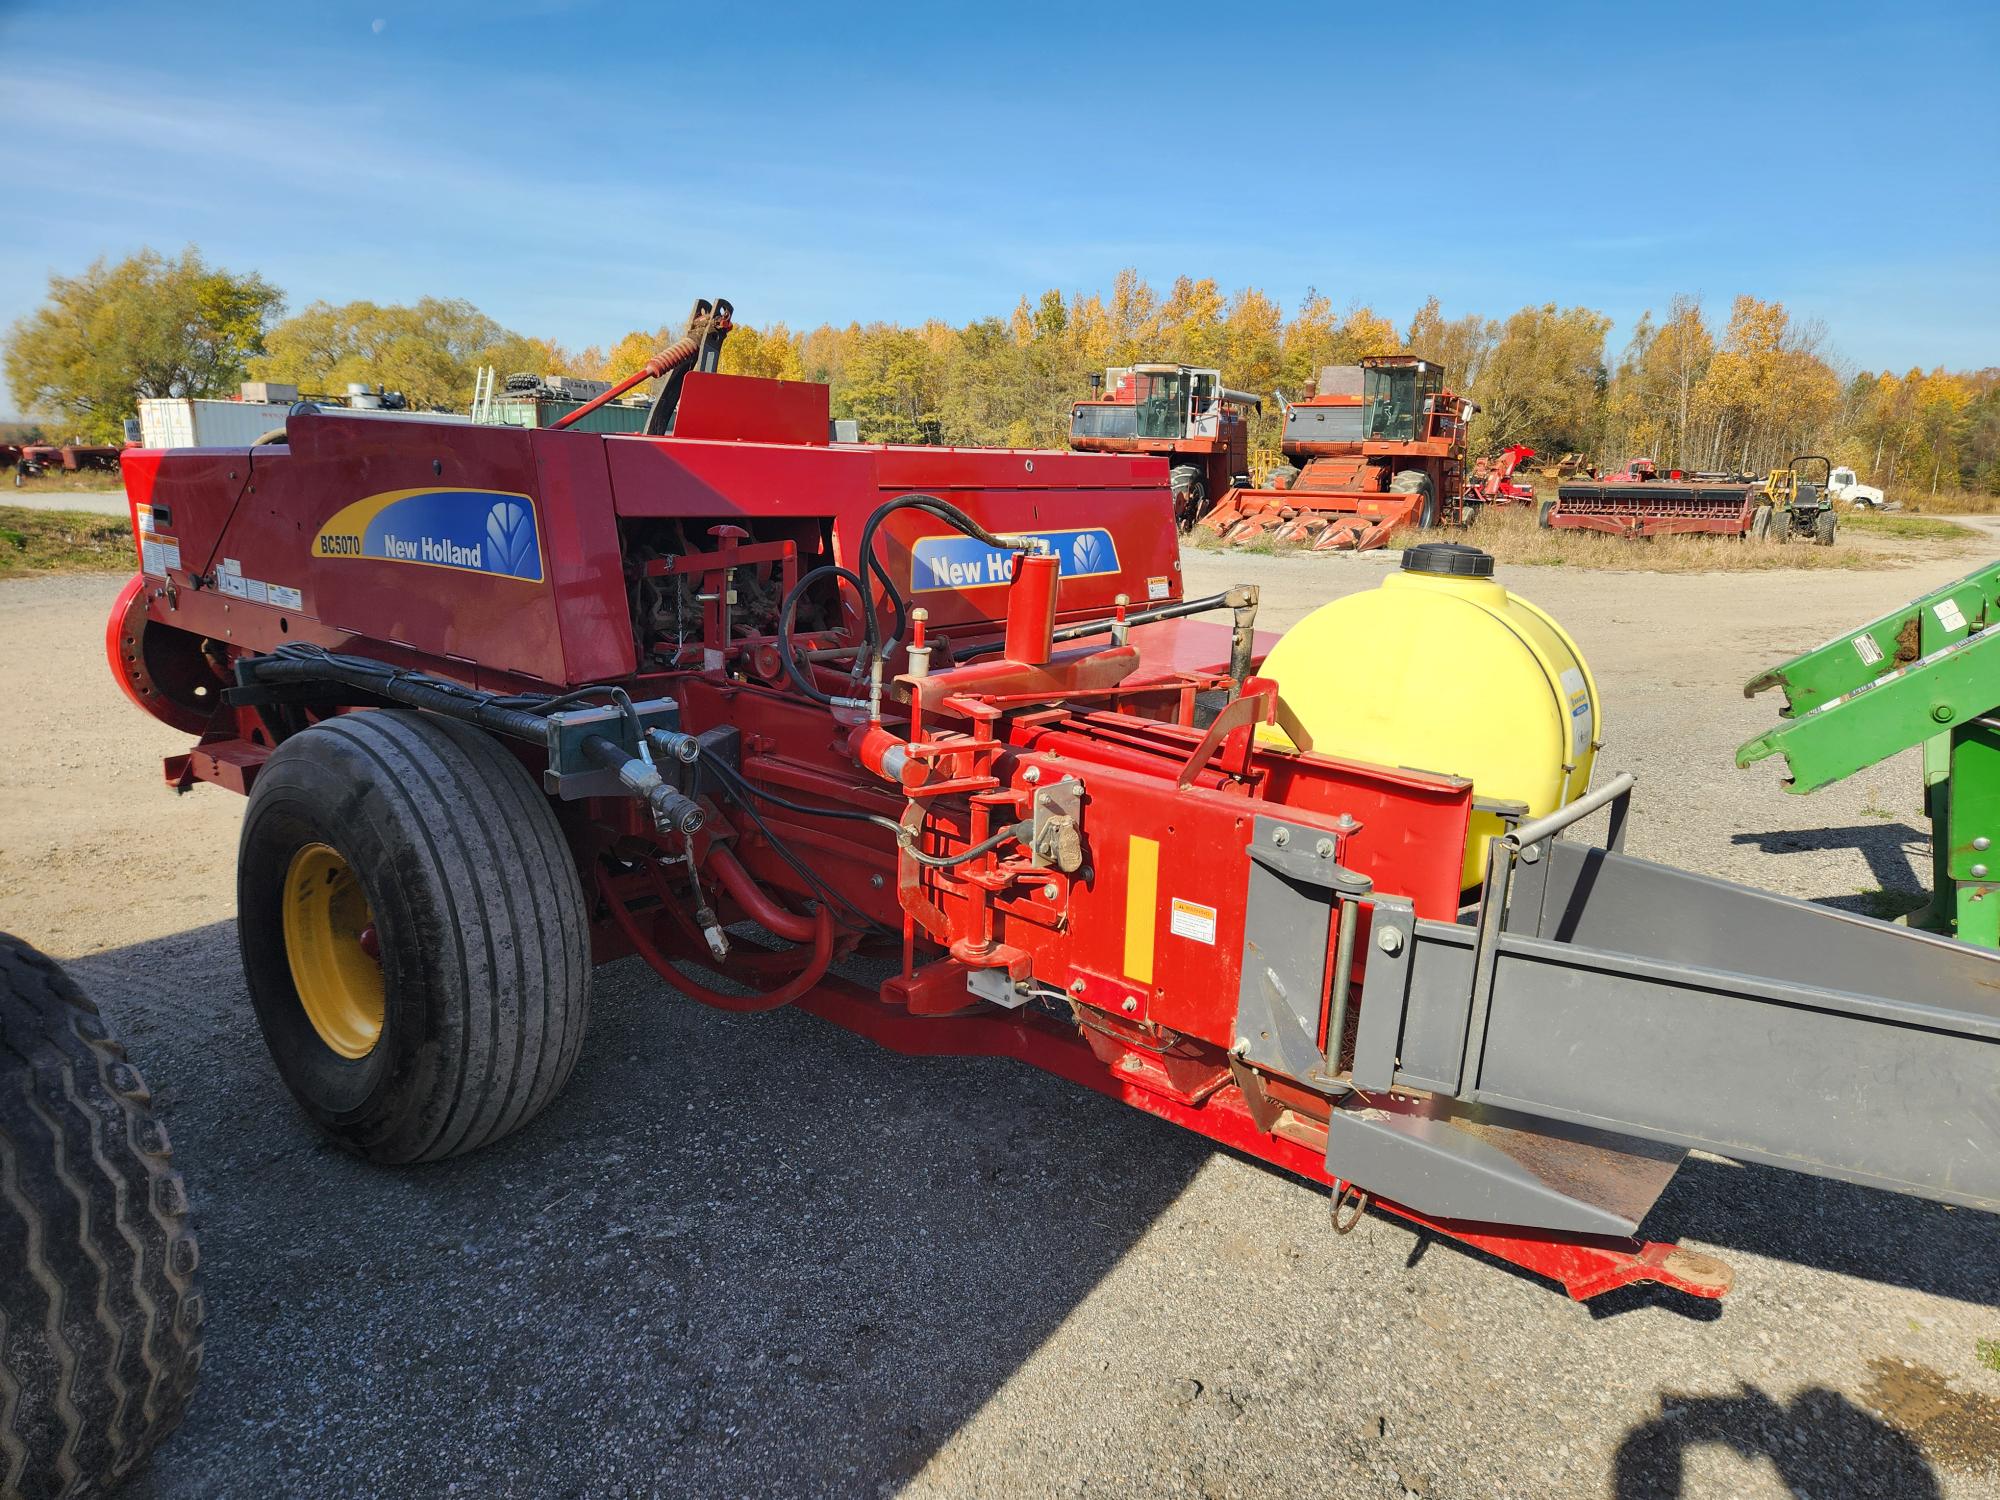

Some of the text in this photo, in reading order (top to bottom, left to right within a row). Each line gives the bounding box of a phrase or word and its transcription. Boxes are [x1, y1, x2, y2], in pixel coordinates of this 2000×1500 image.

[320, 535, 360, 555] BC5070
[384, 534, 482, 568] New Holland
[930, 556, 981, 586] New
